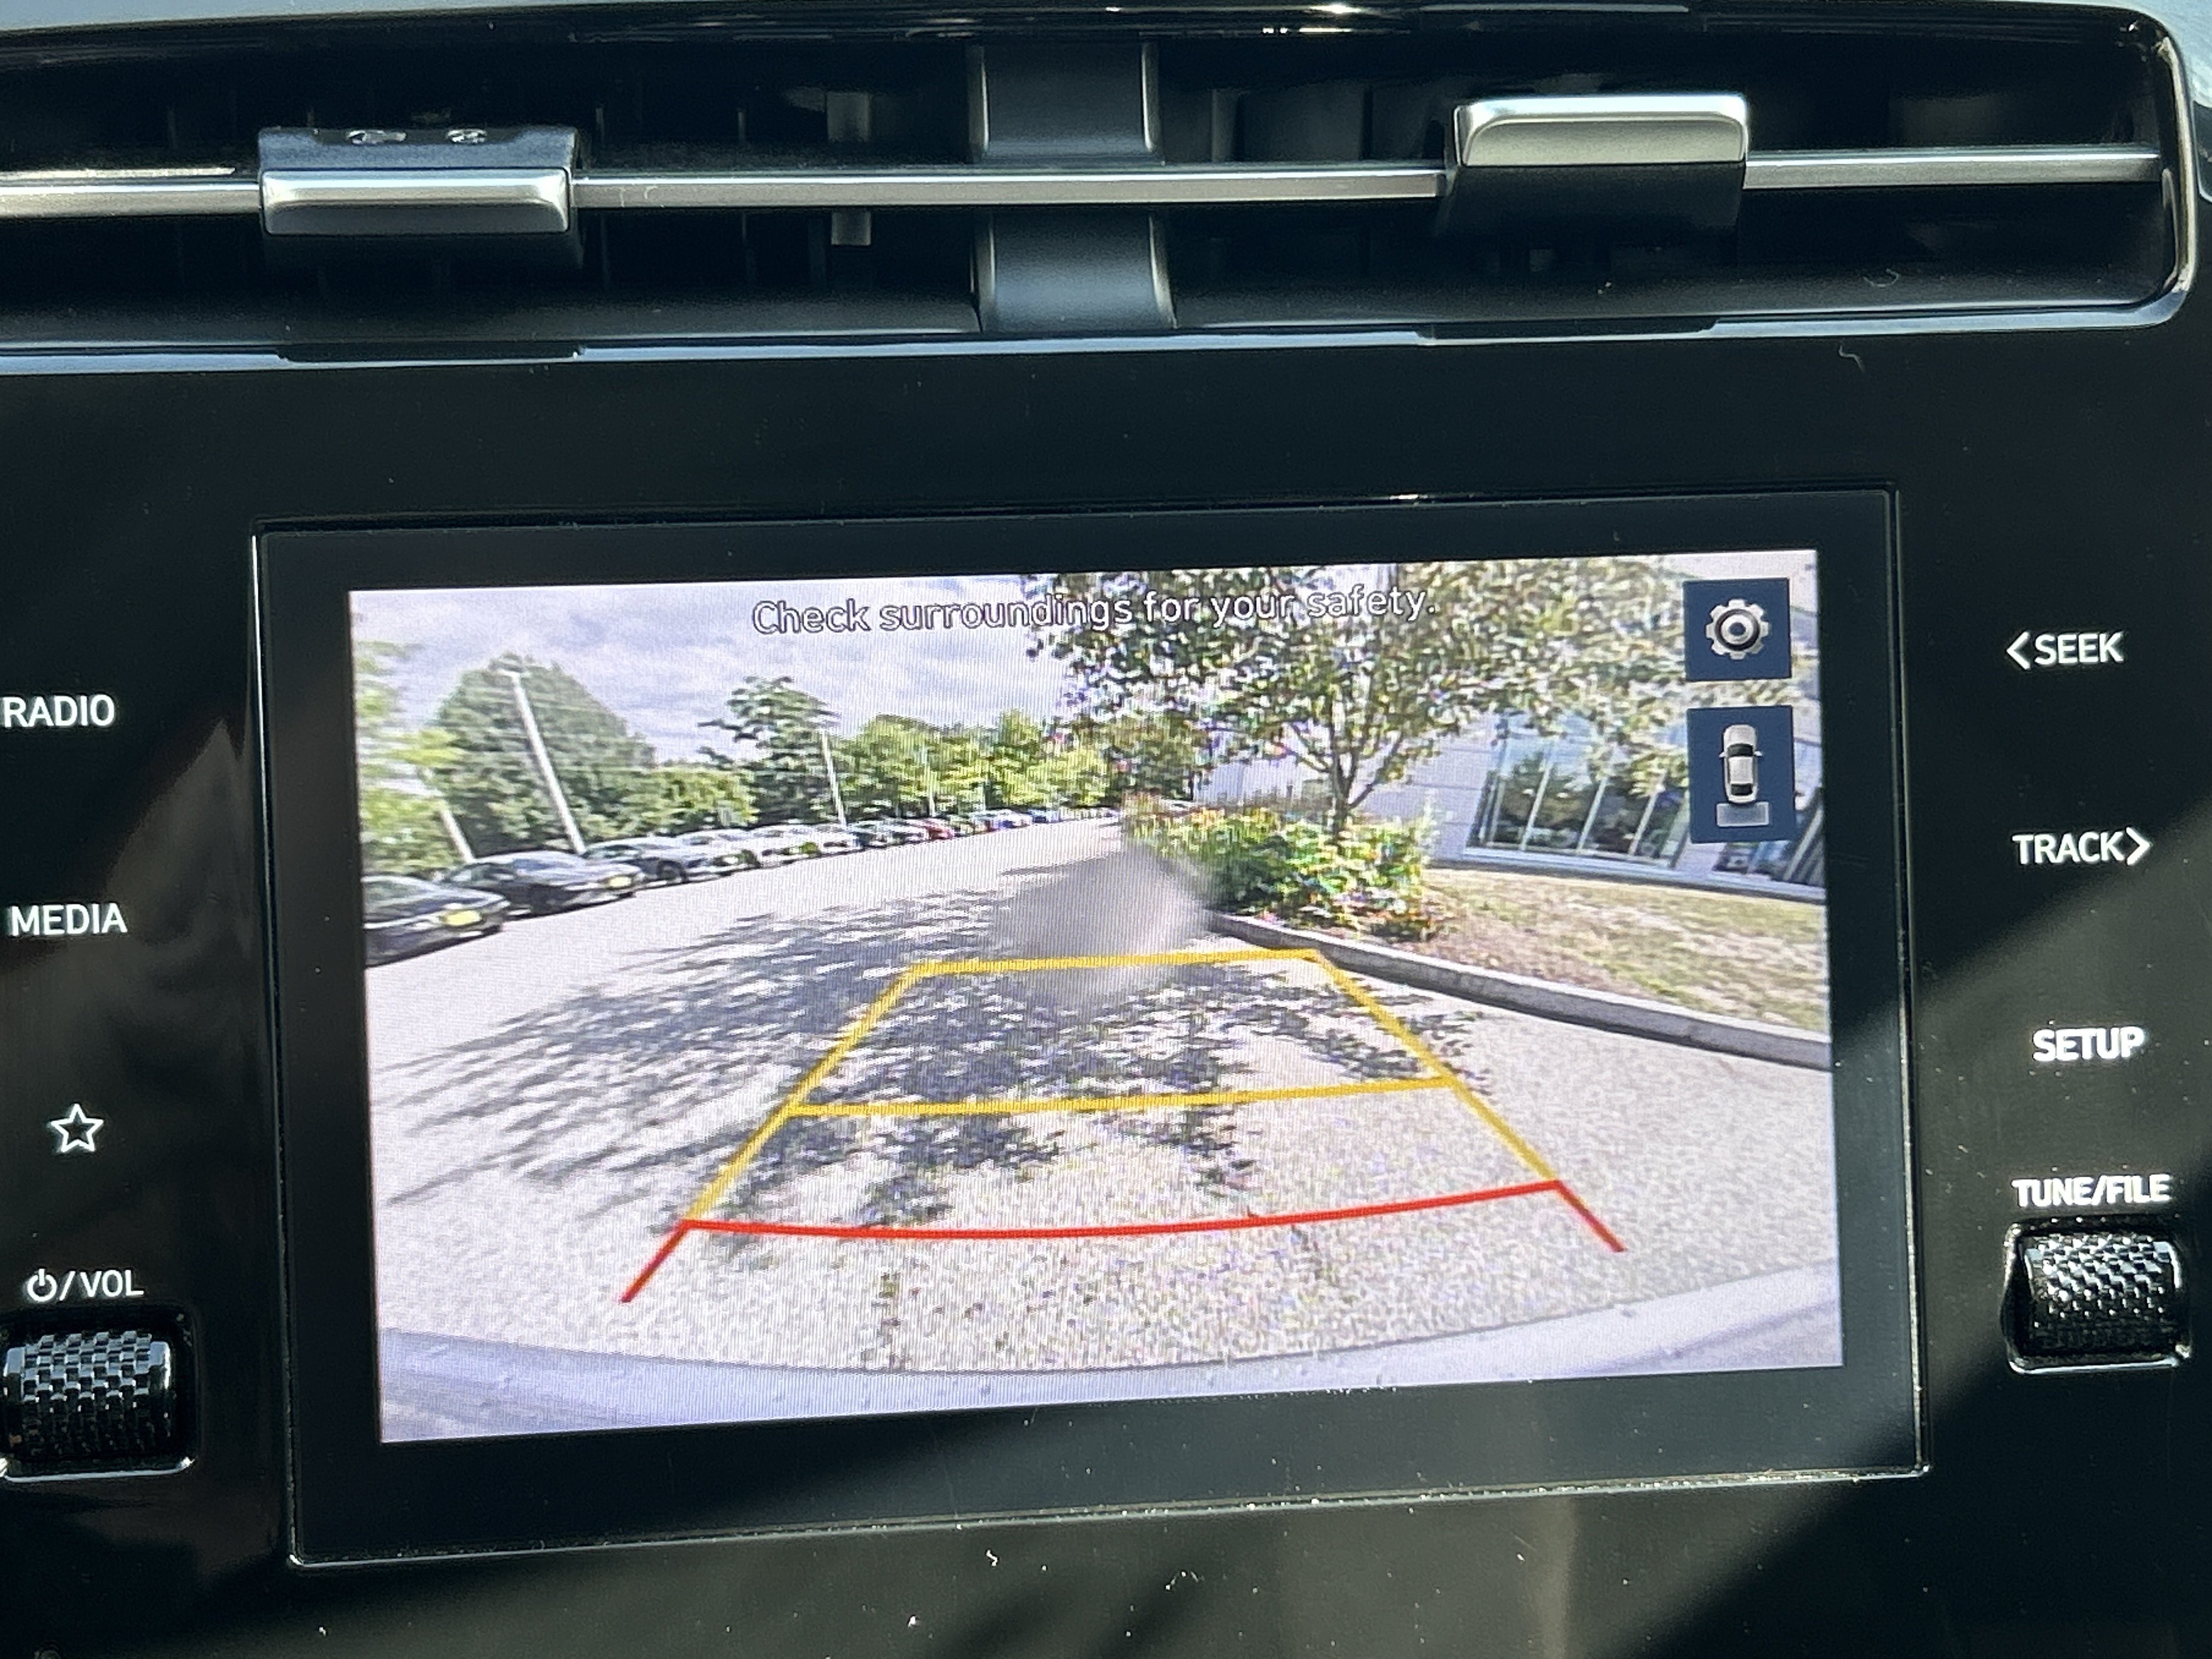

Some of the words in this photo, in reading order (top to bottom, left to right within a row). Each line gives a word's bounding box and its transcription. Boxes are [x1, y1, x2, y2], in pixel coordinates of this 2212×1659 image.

[752, 597, 872, 635] Check
[879, 593, 1133, 631] surroundings
[1144, 590, 1199, 624] for
[1210, 594, 1296, 629] your
[1308, 584, 1436, 623] safety.
[2034, 631, 2124, 666] SEEK
[1, 694, 115, 727] RADIO
[2012, 831, 2126, 864] TRACK
[10, 903, 128, 935] MEDIA
[2033, 1026, 2146, 1062] SETUP
[2011, 1173, 2172, 1207] TUNE/FILE
